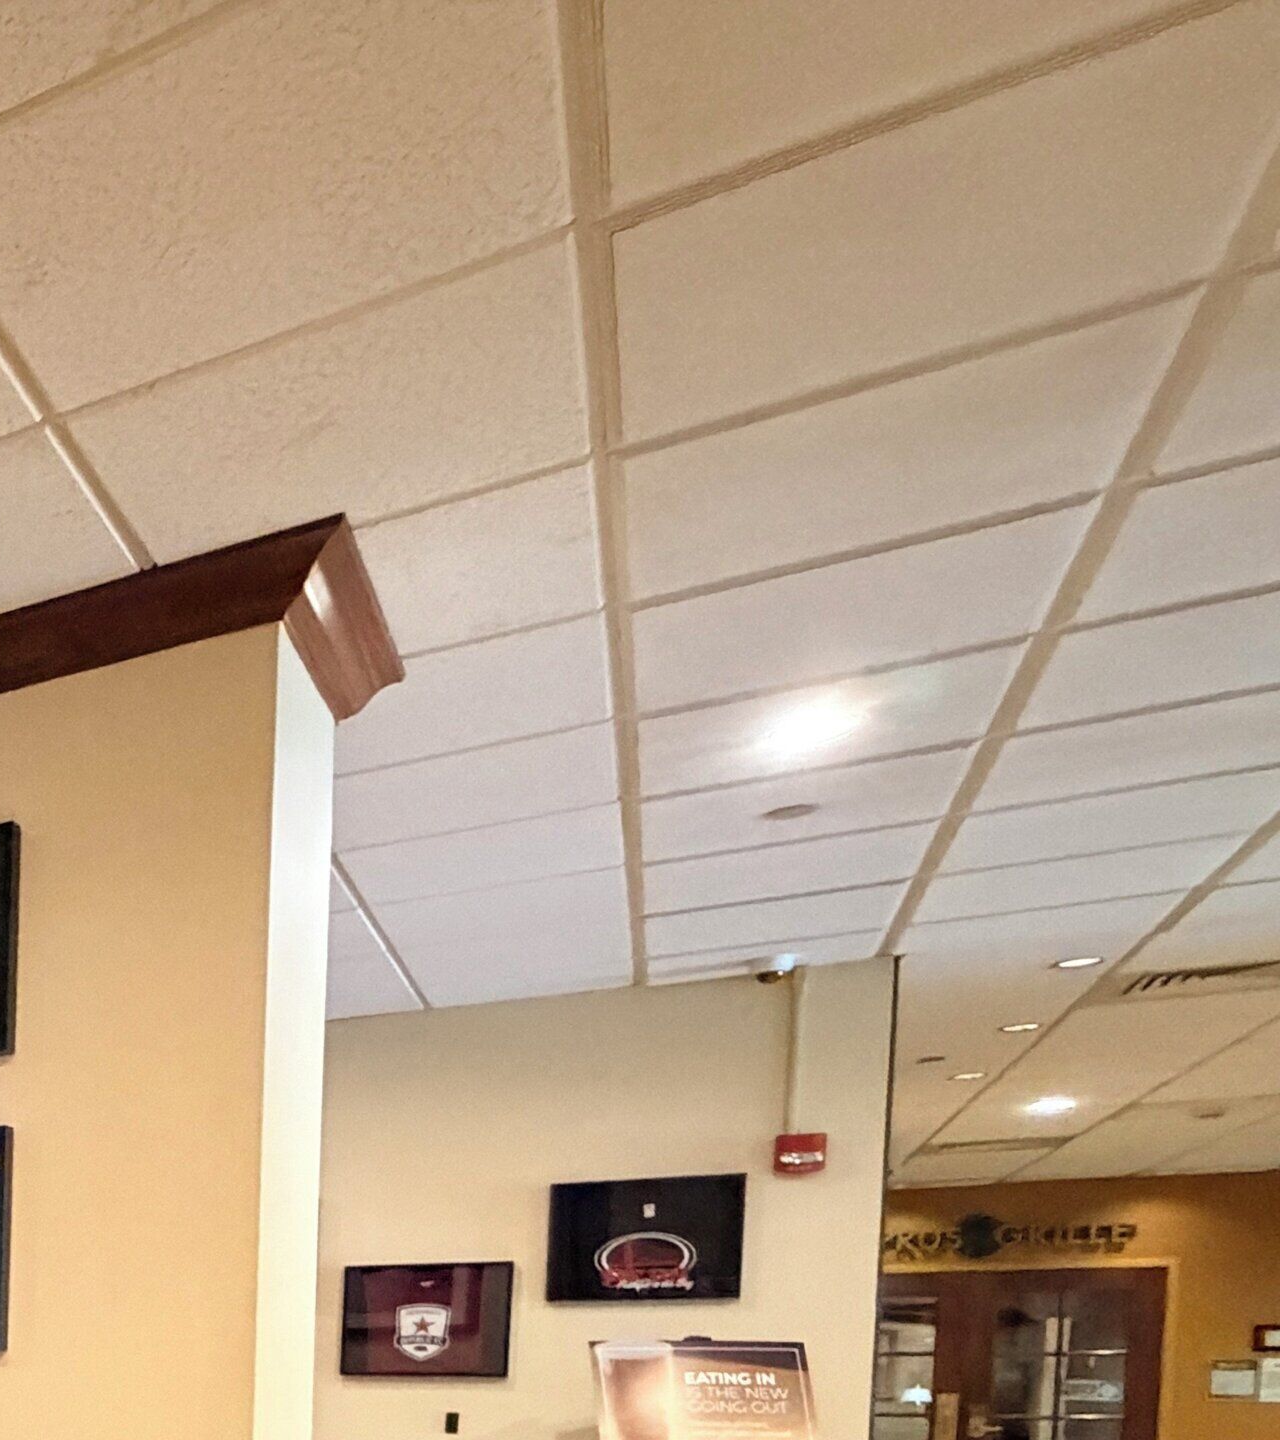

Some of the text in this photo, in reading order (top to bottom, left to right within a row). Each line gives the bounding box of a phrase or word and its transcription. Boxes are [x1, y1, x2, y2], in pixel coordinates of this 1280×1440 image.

[684, 1371, 776, 1386] EATING IN
[704, 1387, 739, 1399] THE
[744, 1388, 789, 1400] NEW
[688, 1400, 788, 1414] GOING OUT
